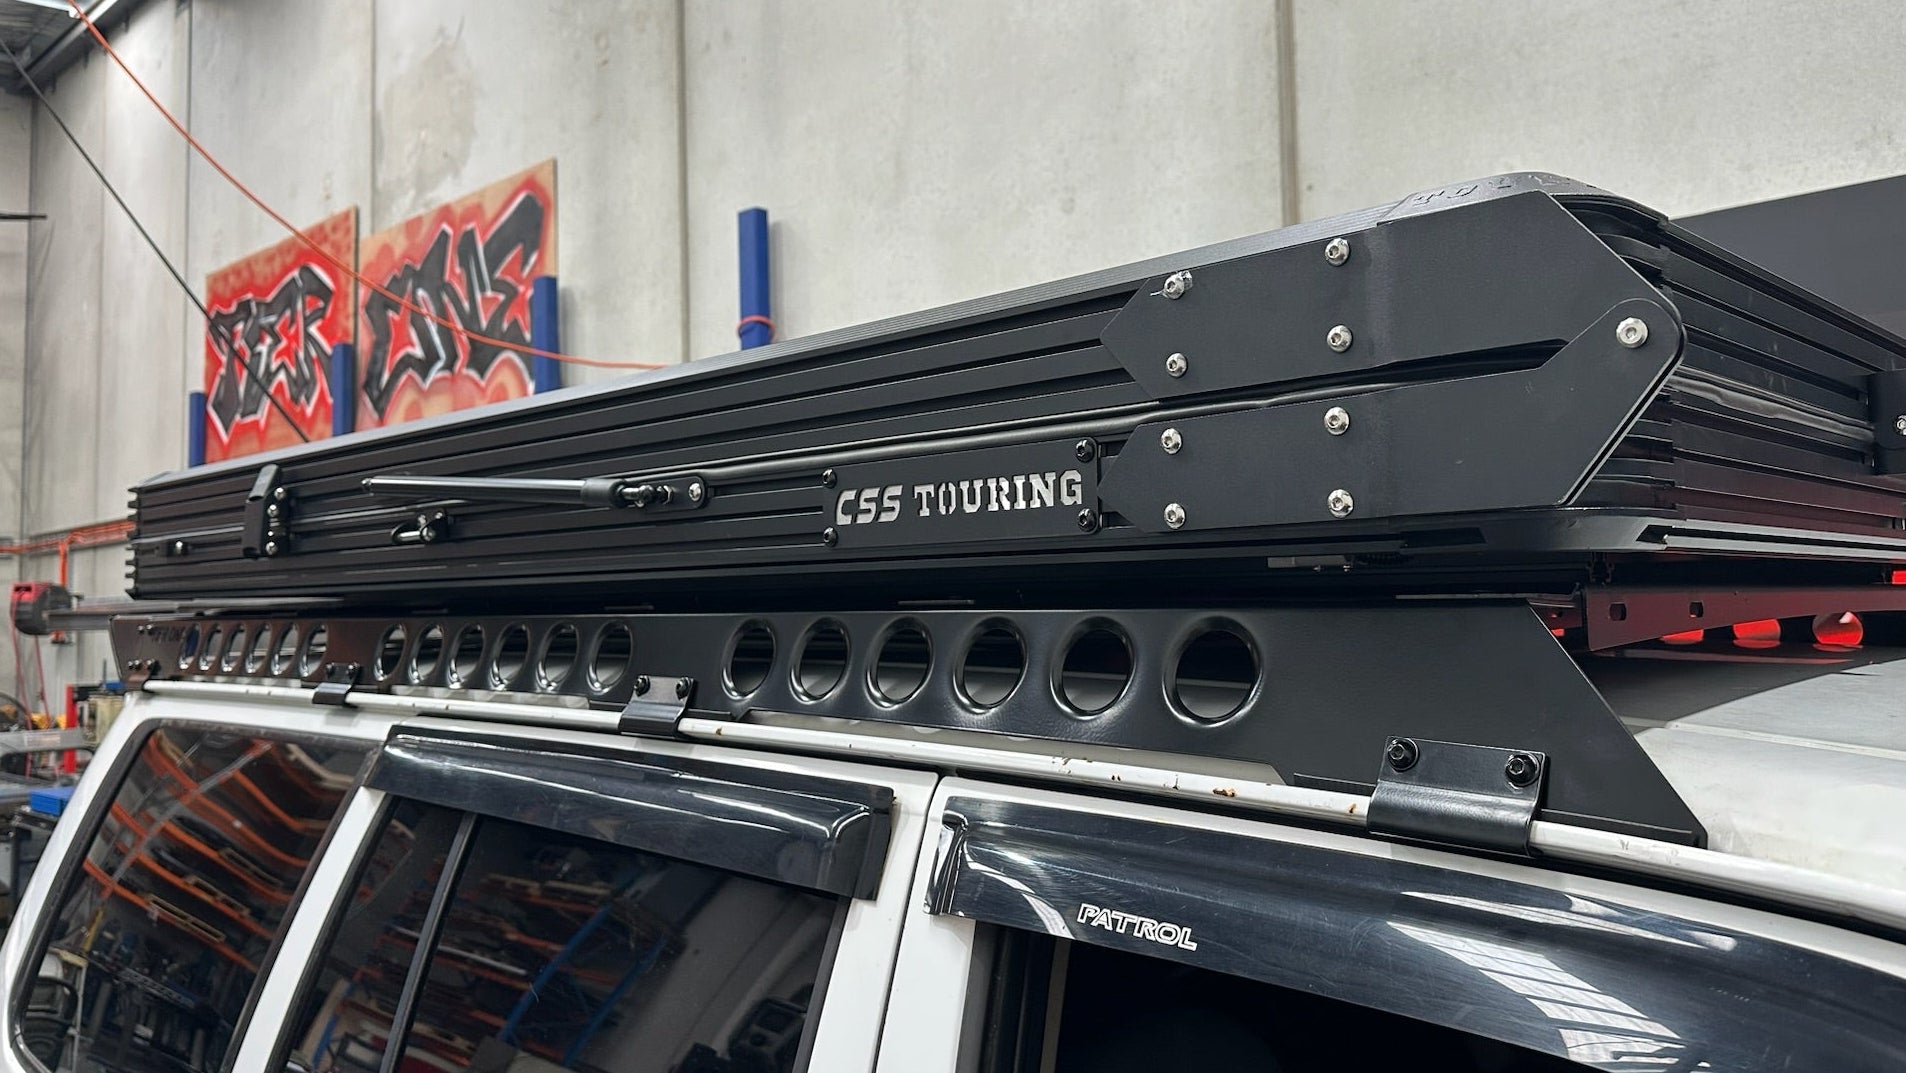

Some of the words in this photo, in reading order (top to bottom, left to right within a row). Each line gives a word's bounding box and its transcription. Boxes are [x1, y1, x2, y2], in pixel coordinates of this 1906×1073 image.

[836, 485, 903, 525] CSS
[914, 470, 1083, 517] TOURING
[1077, 903, 1198, 951] PATROL
